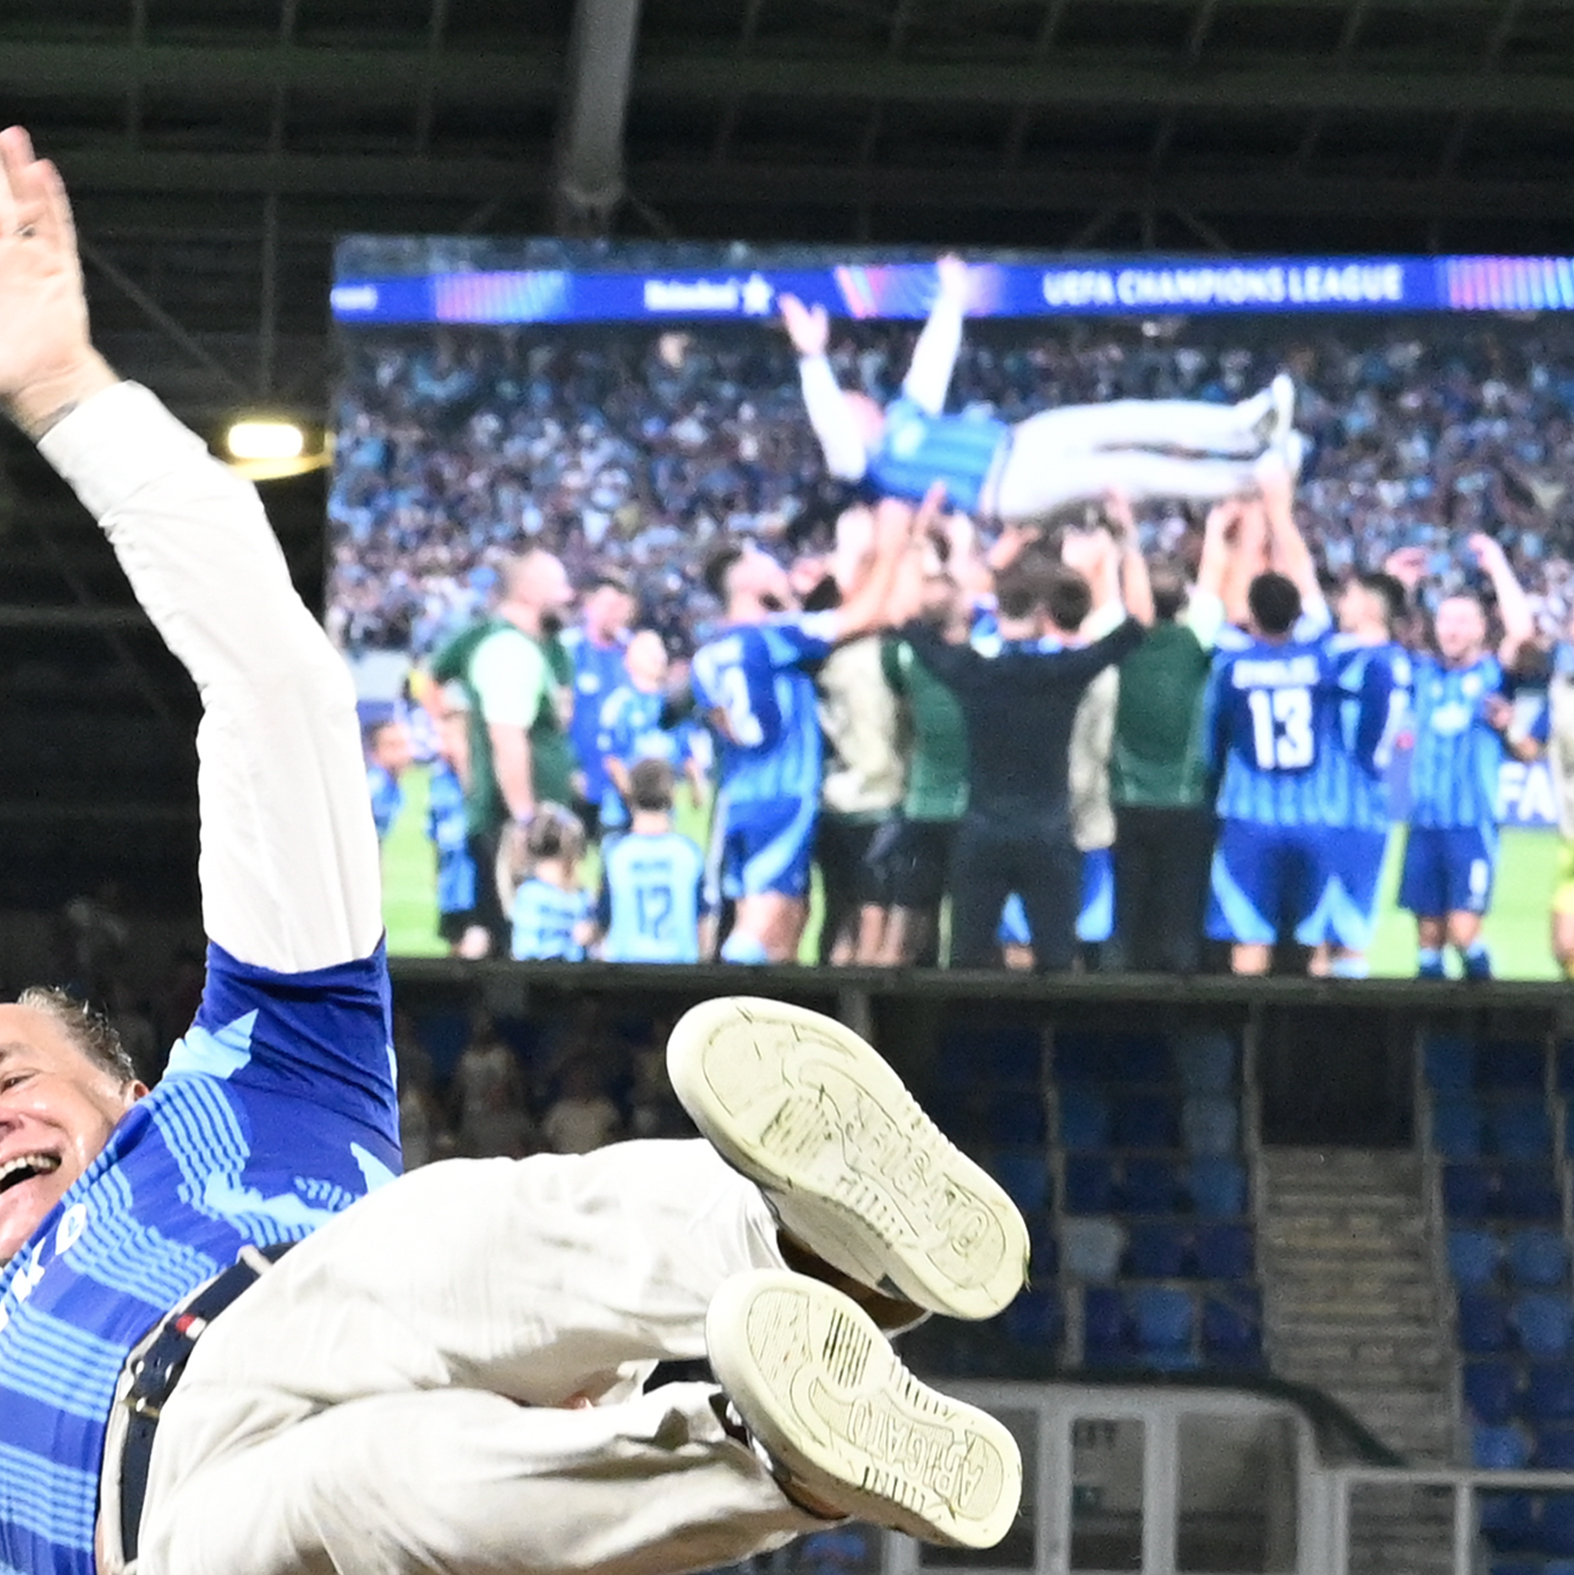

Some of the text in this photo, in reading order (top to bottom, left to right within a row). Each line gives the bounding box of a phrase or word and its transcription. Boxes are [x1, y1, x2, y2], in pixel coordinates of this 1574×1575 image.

[1042, 266, 1402, 306] UEFA CHAMPIONS LEAGUE
[1248, 689, 1314, 771] 13
